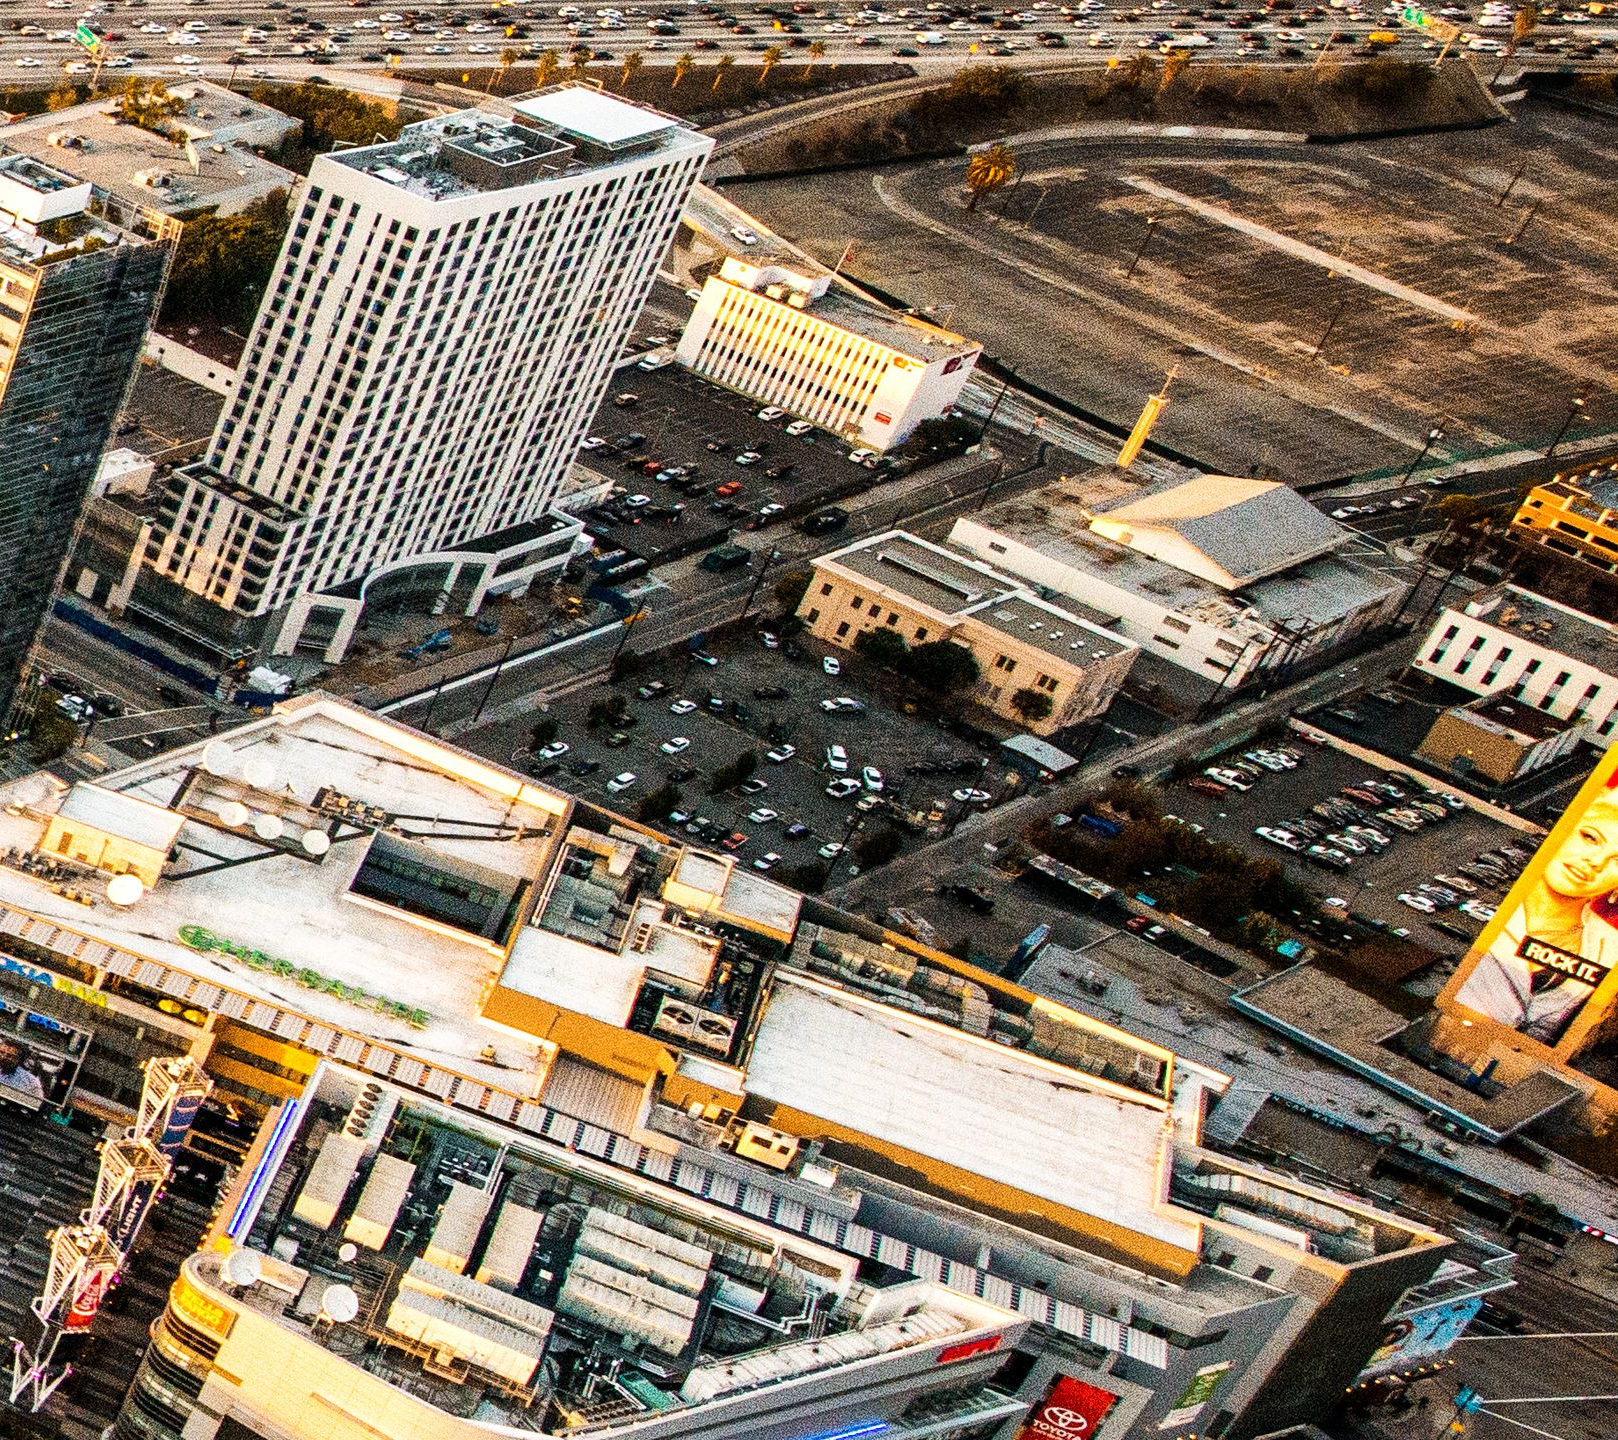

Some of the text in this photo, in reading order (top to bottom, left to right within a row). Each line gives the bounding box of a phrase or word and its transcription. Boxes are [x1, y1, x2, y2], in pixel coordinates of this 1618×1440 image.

[1526, 942, 1599, 983] ROCK IT.
[1312, 1110, 1345, 1129] WASH
